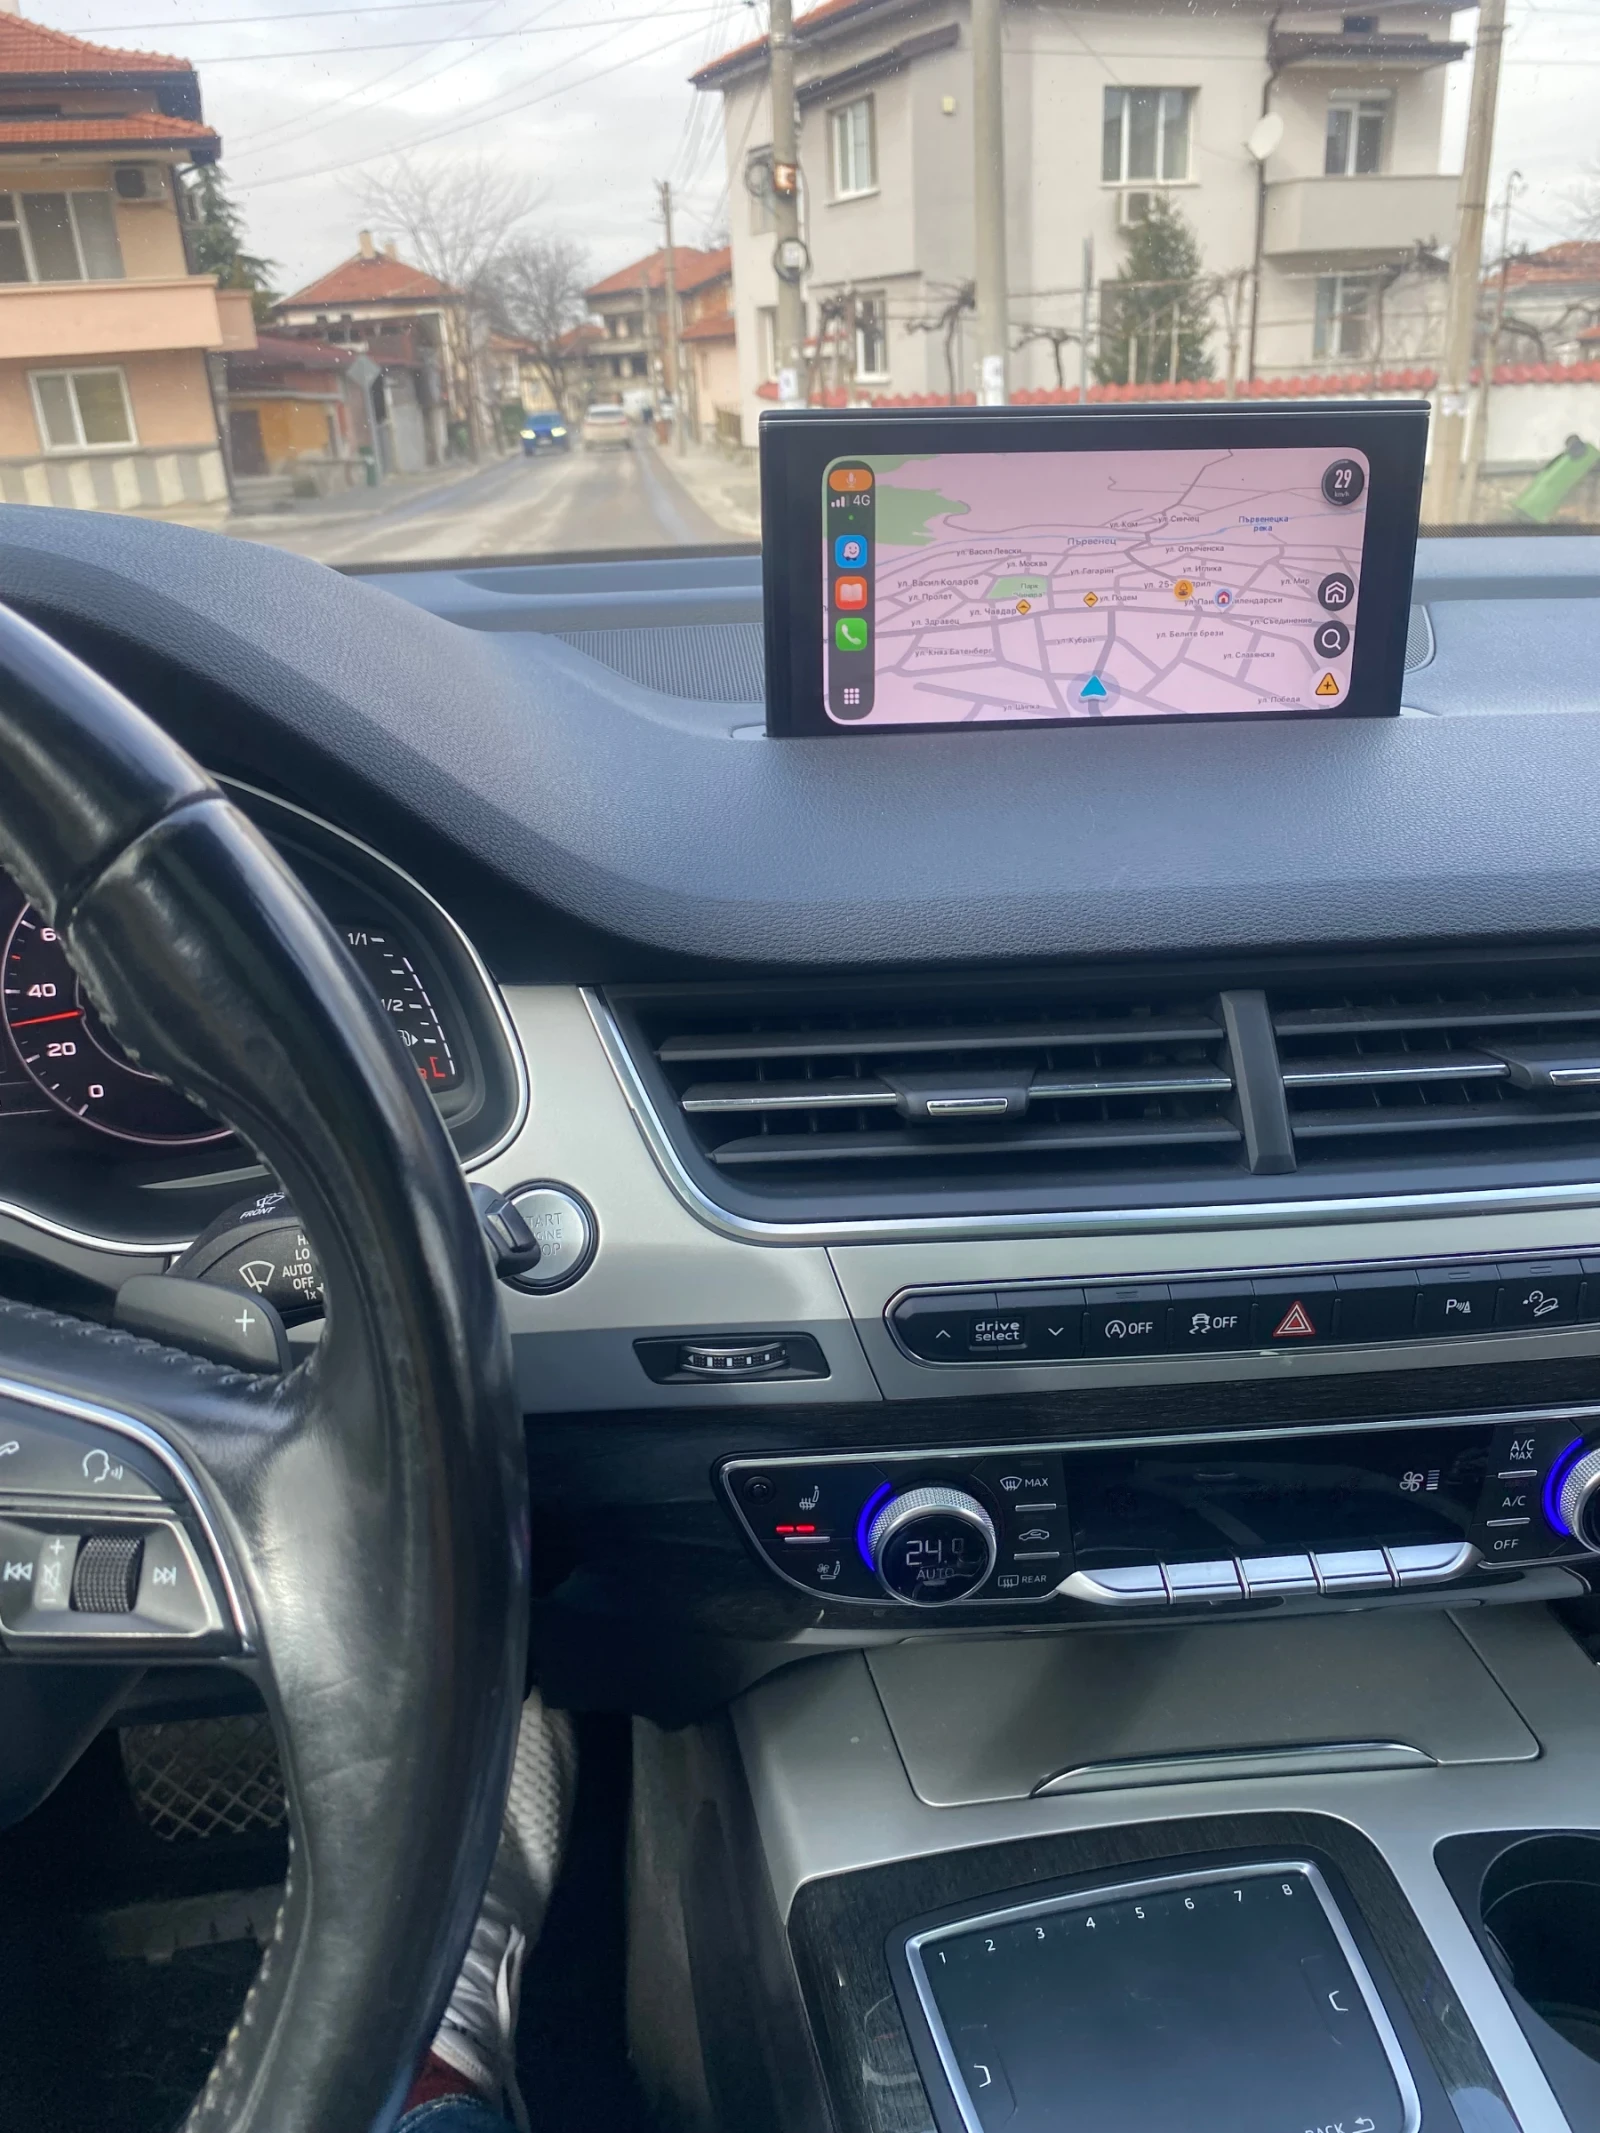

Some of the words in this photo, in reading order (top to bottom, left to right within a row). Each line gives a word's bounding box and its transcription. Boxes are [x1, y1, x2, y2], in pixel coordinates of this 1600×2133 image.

[1334, 468, 1353, 489] 29
[852, 494, 871, 506] 4G
[1334, 490, 1350, 498] km/h
[1238, 515, 1289, 524] Първенецка
[1067, 537, 1117, 546] Първенец
[969, 548, 992, 556] Васил
[994, 547, 1022, 555] Левски
[1019, 559, 1048, 568] Москва
[1195, 565, 1222, 573] Иглика
[1082, 567, 1114, 575] Гагарин
[912, 579, 938, 587] Васил
[940, 578, 979, 587] Коларов
[1020, 582, 1039, 590] Парк
[1192, 580, 1212, 588] прил
[1293, 577, 1310, 586] Мир
[921, 593, 953, 601] Пролет
[1111, 594, 1138, 602] Подем
[1233, 597, 1283, 606] илендарски
[984, 607, 1017, 616] Чавдар
[924, 618, 960, 627] Здравец
[1262, 617, 1313, 625] Съединение
[1169, 630, 1198, 638] Белите
[1199, 629, 1224, 638] брези
[1068, 637, 1096, 645] Кубрат
[949, 647, 992, 656] Батенберг
[40, 927, 61, 942] 6
[347, 932, 368, 946] 1/1
[26, 983, 57, 998] 40
[46, 1041, 77, 1057] 20
[88, 1084, 104, 1098] 0
[239, 1206, 277, 1220] FRONT
[524, 1212, 562, 1229] TART
[297, 1234, 309, 1246] H
[535, 1228, 563, 1241] GINE
[295, 1248, 311, 1261] LO
[541, 1242, 562, 1256] OP
[282, 1262, 313, 1278] AUTO
[292, 1276, 314, 1290] OFF
[304, 1289, 317, 1301] 1x
[975, 1320, 1020, 1333] drive
[1127, 1321, 1153, 1335] OFF
[1212, 1315, 1239, 1329] OFF
[975, 1330, 1020, 1342] select
[1510, 1438, 1535, 1452] A/C
[1509, 1450, 1533, 1461] MAX
[1024, 1477, 1049, 1488] MAX
[1501, 1495, 1527, 1508] A/C
[1493, 1538, 1520, 1551] OFF
[915, 1566, 956, 1581] AUTO
[1021, 1574, 1047, 1585] REAR
[938, 1951, 947, 1965] 1
[984, 1938, 997, 1952] 2
[1035, 1926, 1046, 1939] 3
[1085, 1916, 1096, 1930] 4
[1134, 1906, 1145, 1919] 5
[1184, 1897, 1195, 1910] 6
[1233, 1889, 1243, 1903] 7
[1281, 1883, 1294, 1896] 8
